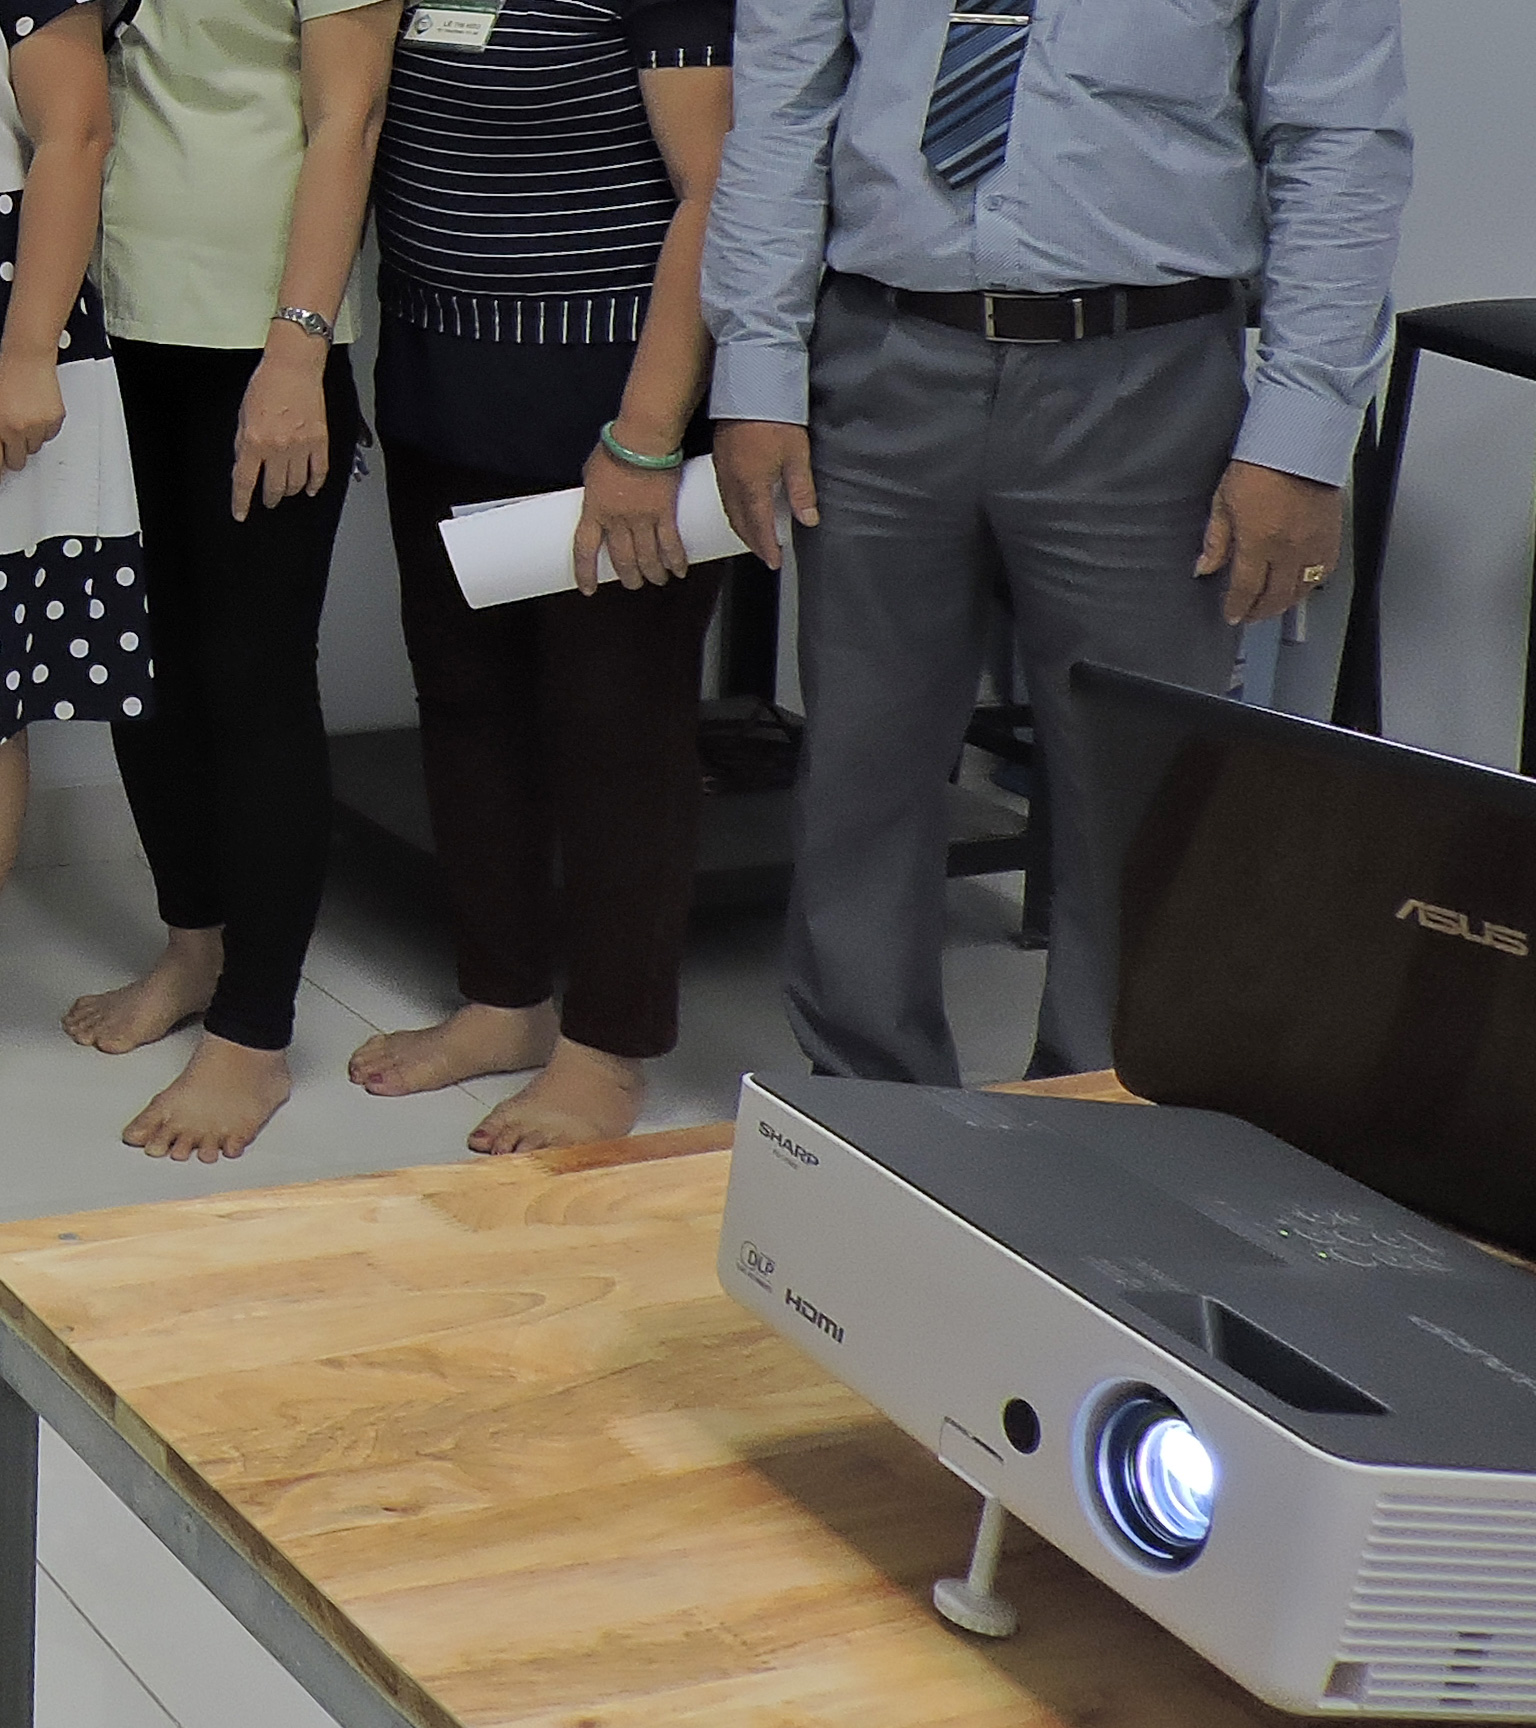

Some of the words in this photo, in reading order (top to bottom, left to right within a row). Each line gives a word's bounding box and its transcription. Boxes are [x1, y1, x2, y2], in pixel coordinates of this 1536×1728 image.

[1394, 899, 1529, 957] ASUS
[757, 1120, 821, 1167] SHARP
[746, 1248, 777, 1276] DLP
[784, 1287, 845, 1345] HDMI
